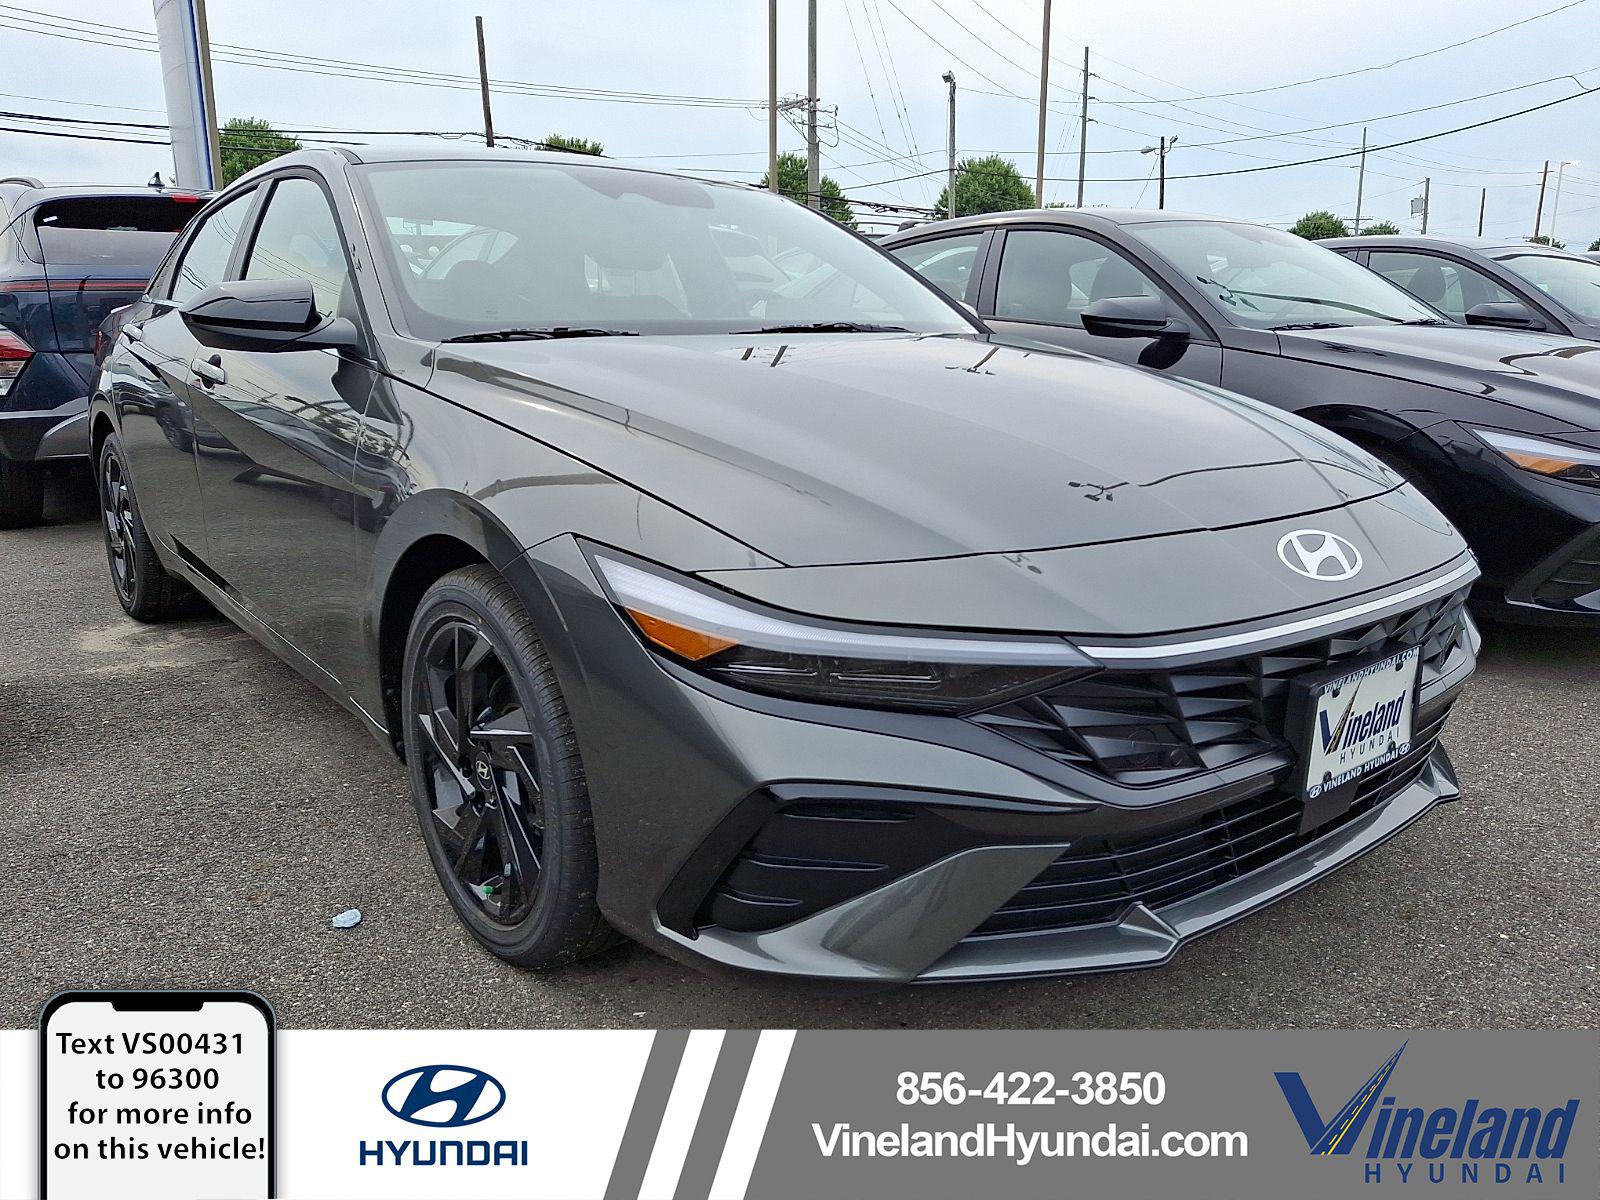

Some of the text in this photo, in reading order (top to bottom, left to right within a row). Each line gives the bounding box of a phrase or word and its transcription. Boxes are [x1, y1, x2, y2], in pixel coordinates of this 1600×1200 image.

[1319, 677, 1406, 756] Vineland
[1339, 726, 1401, 764] HYUNDAI
[1323, 749, 1399, 793] VINELAND HYUNDAI
